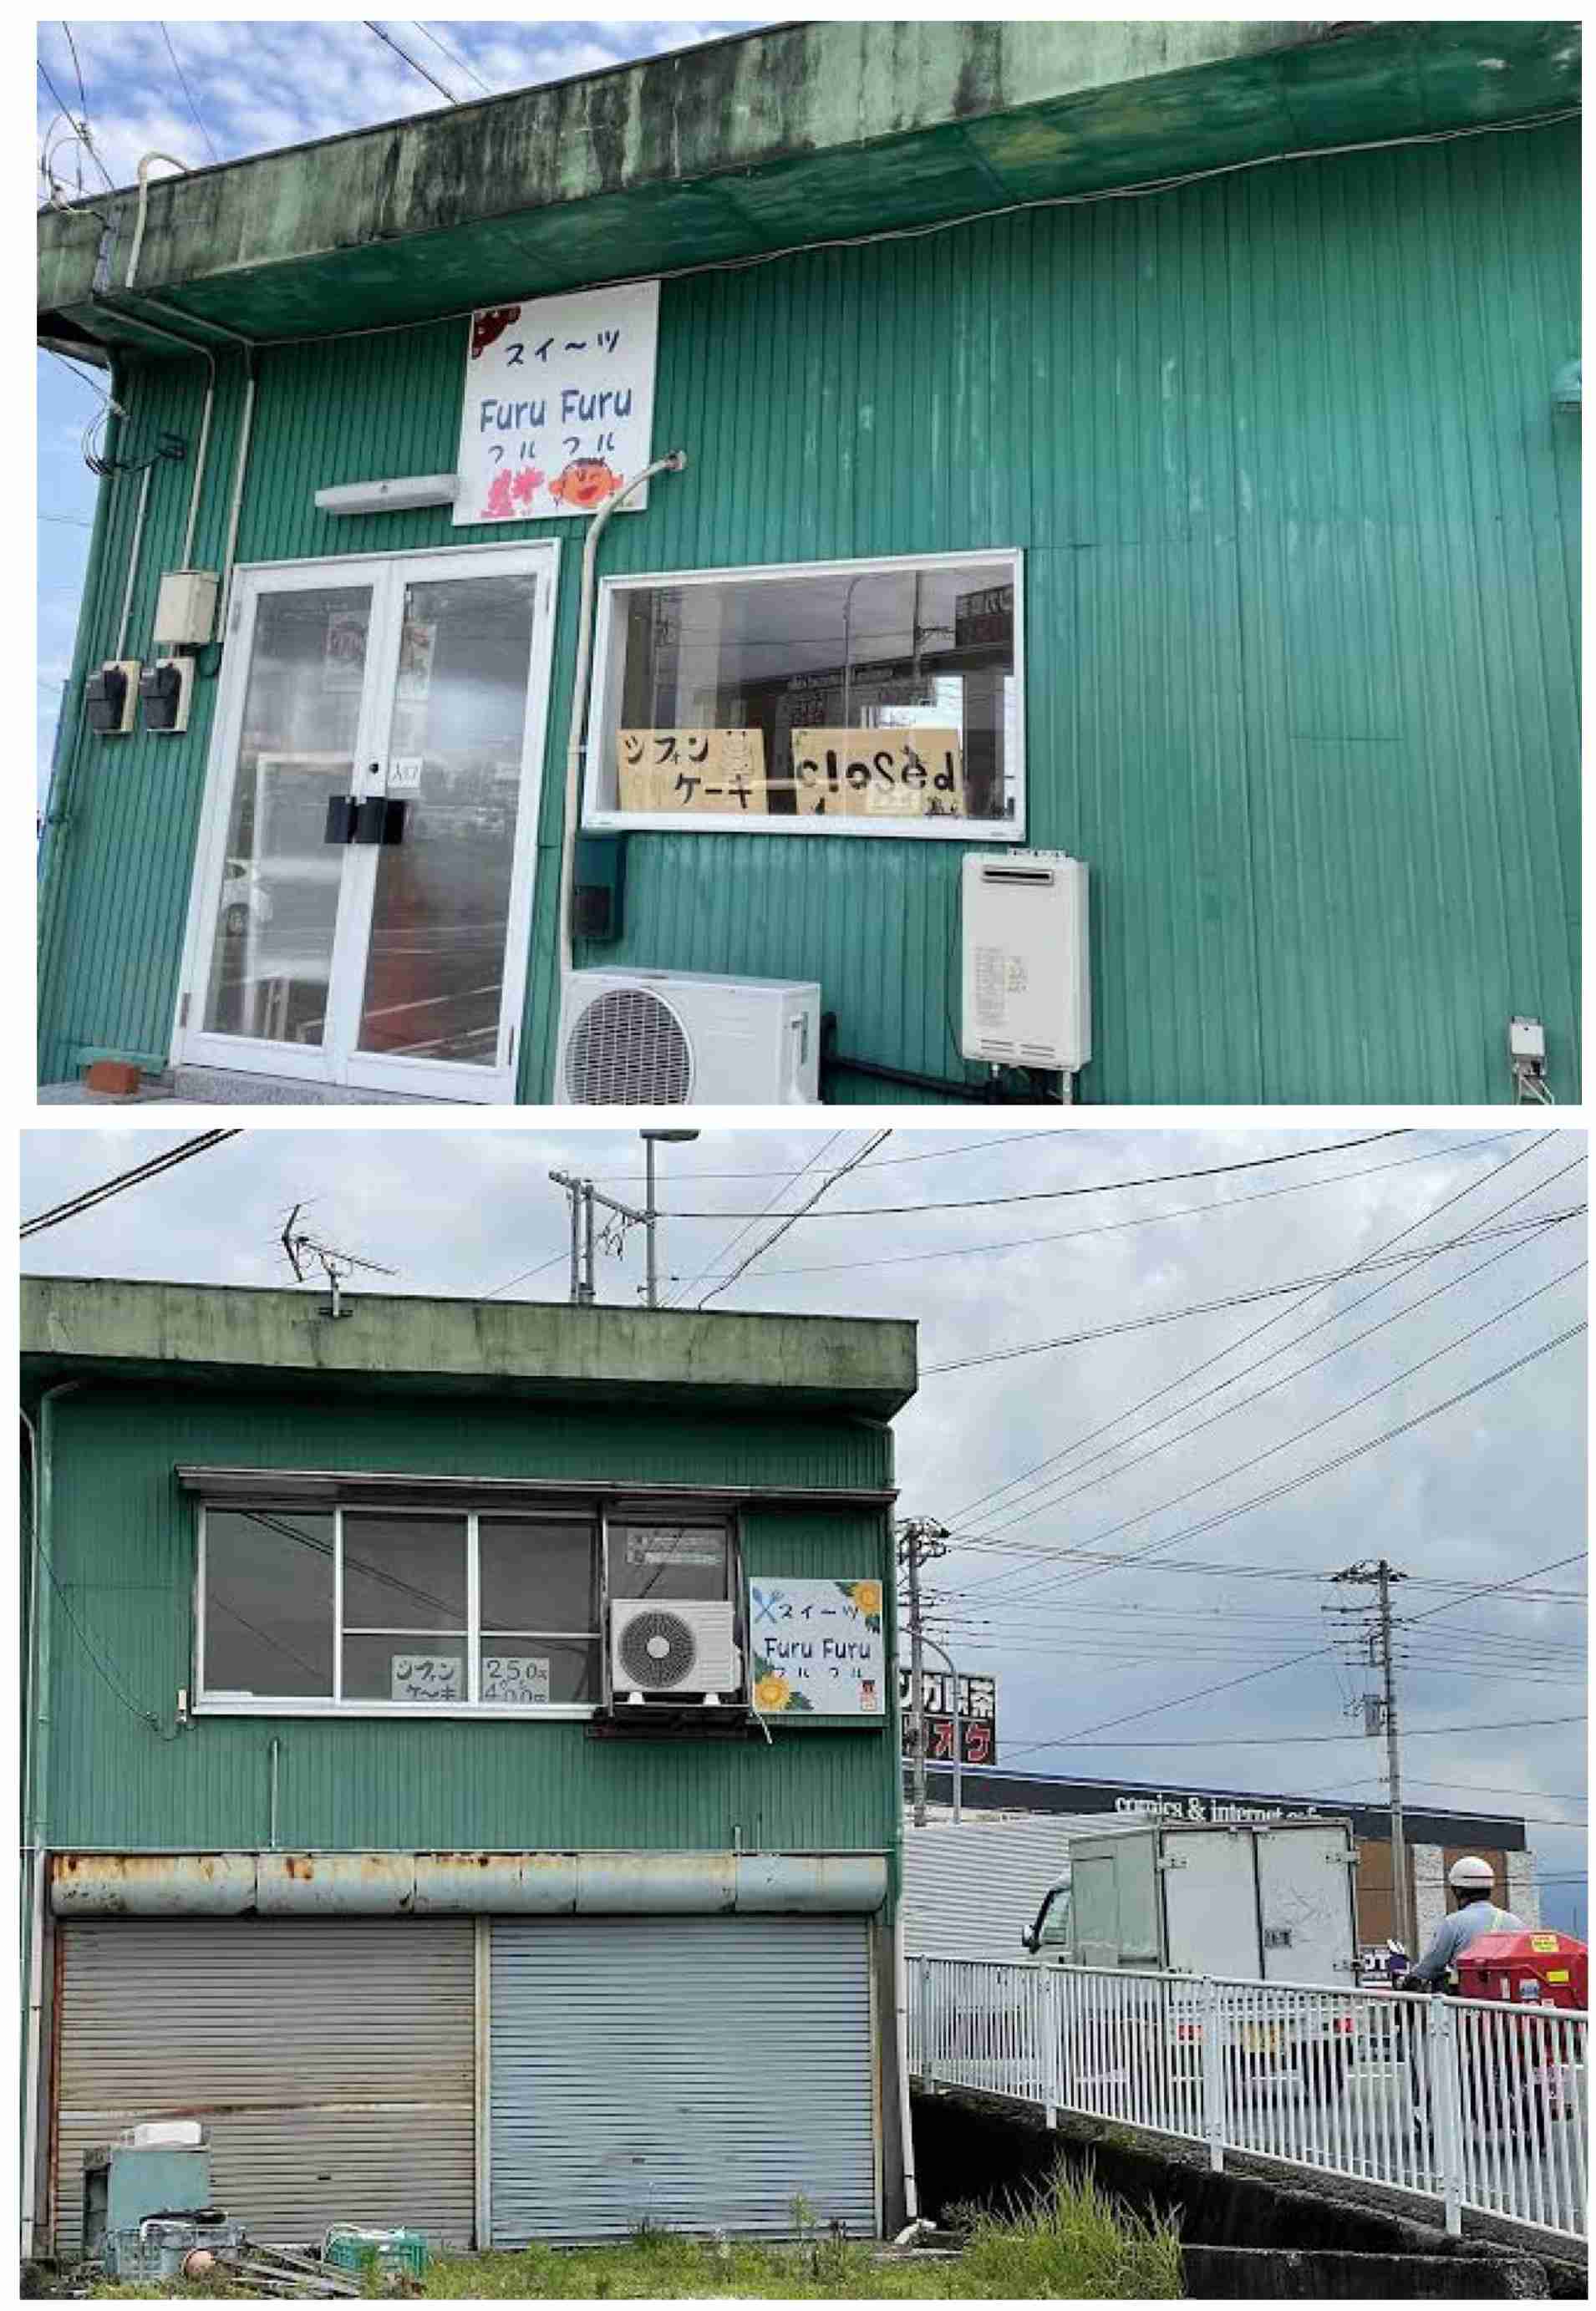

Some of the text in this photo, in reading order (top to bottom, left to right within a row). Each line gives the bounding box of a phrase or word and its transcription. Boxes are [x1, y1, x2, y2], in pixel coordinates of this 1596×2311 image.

[480, 388, 632, 432] Furu Furu
[675, 772, 752, 809] ケーキ
[764, 1638, 871, 1658] Furu Furu
[1115, 1793, 1182, 1818] comics
